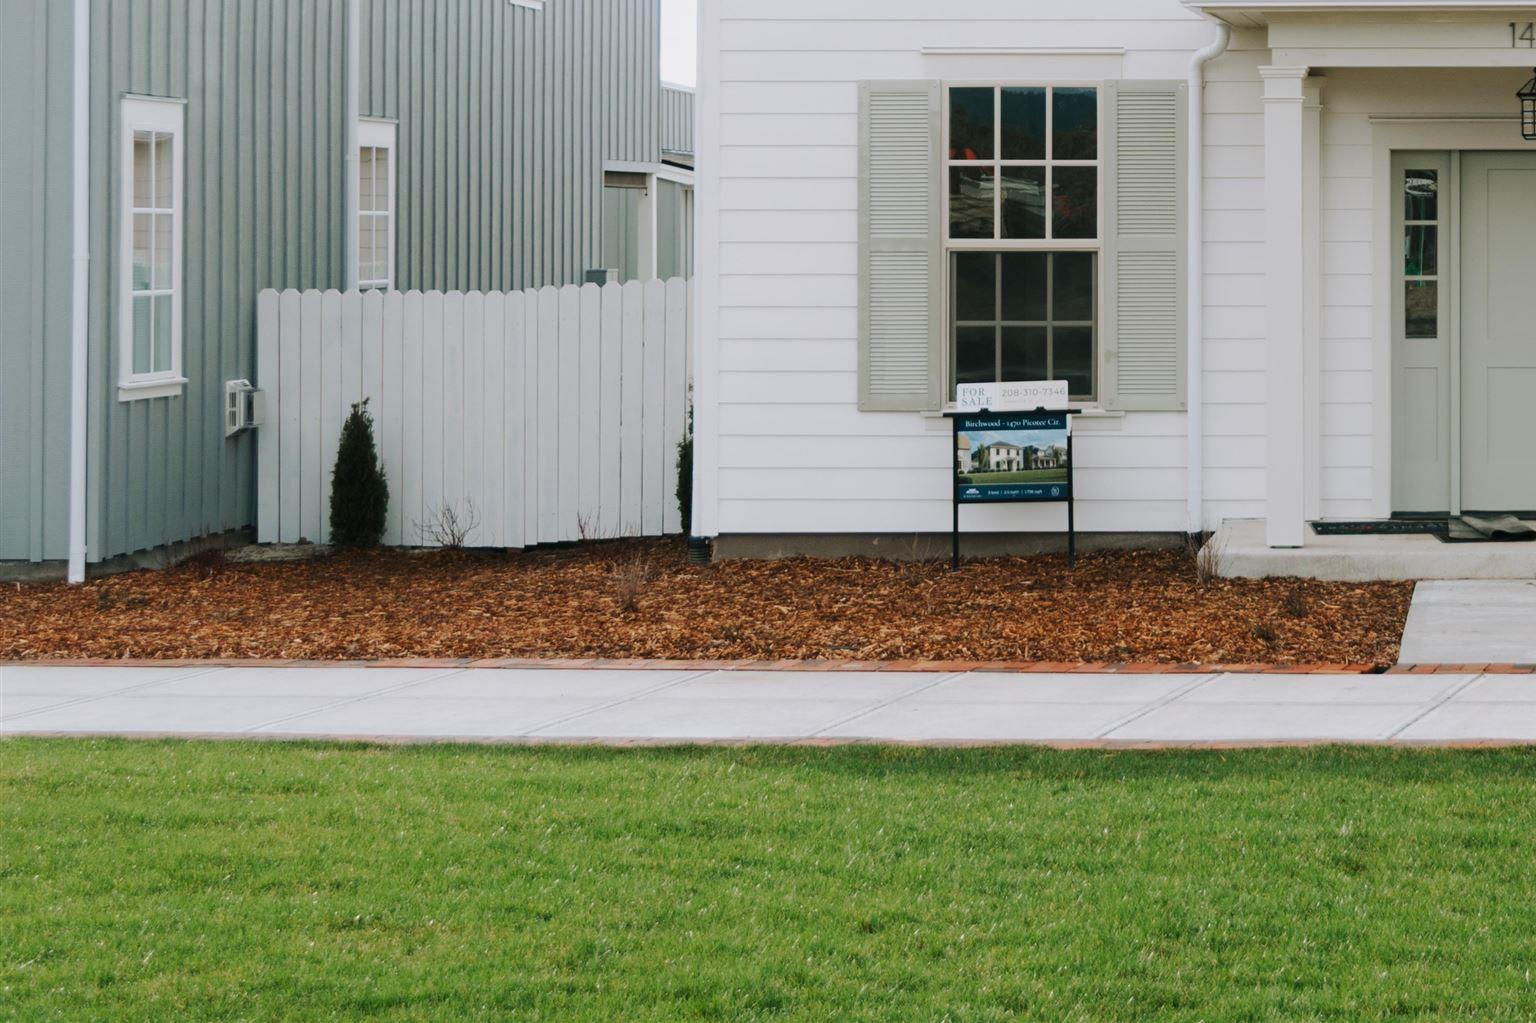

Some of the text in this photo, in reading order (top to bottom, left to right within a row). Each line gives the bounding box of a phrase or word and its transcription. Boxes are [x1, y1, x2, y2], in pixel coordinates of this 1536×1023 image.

[962, 387, 985, 397] FOR
[962, 396, 993, 407] SALE
[965, 418, 1001, 428] Birchwood
[1006, 420, 1021, 429] 1470
